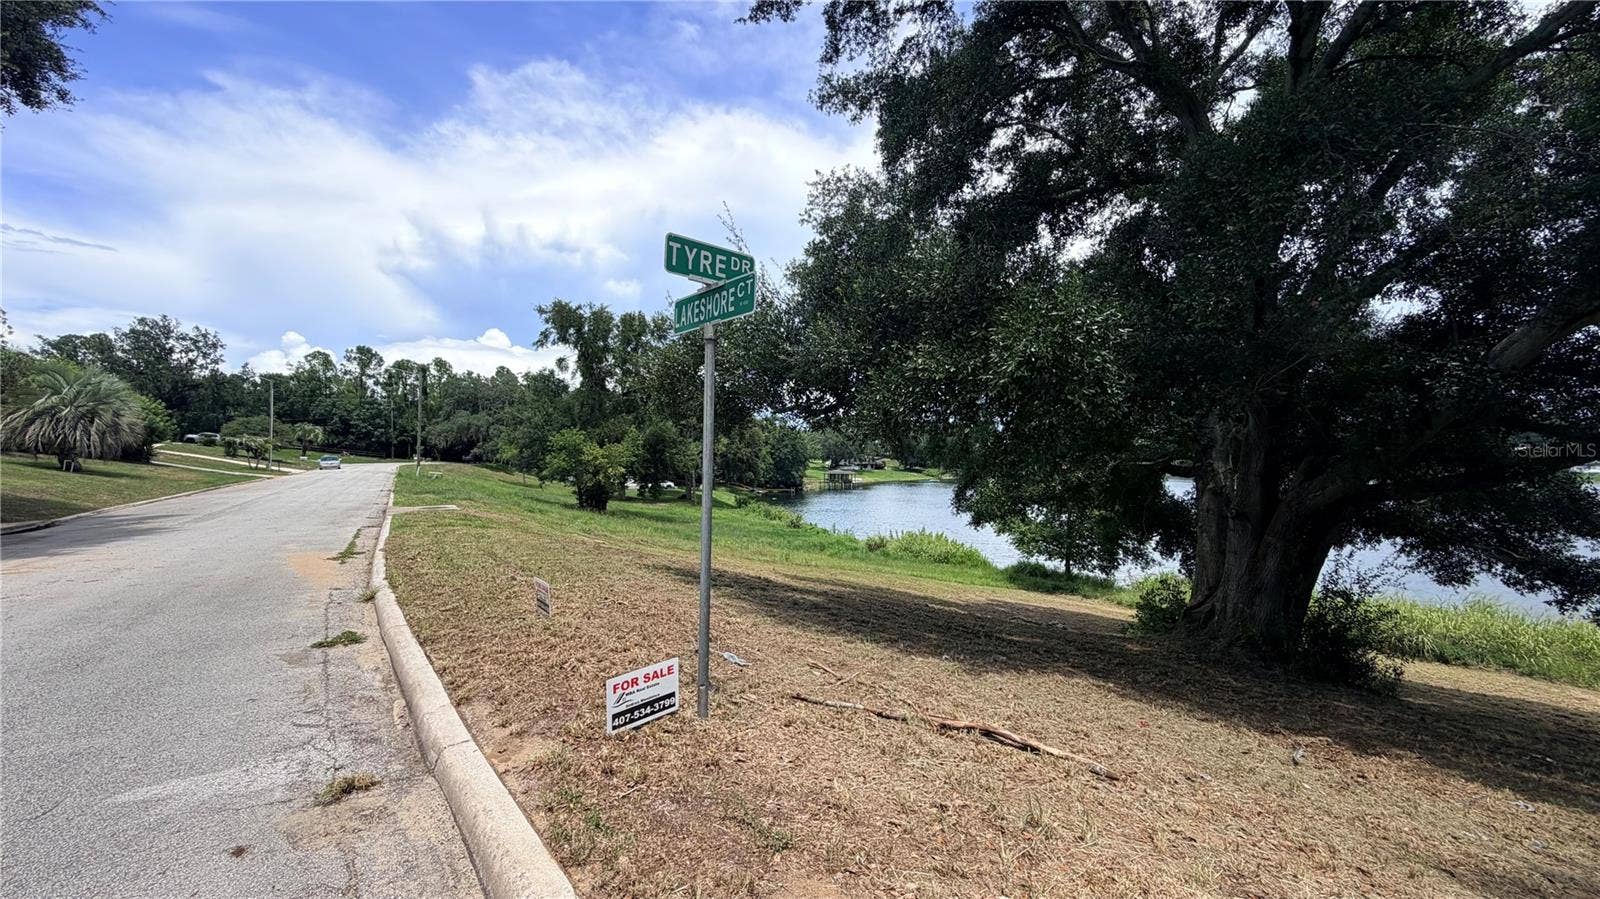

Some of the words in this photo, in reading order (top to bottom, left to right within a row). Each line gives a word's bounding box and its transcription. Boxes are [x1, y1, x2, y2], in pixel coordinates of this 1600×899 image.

[668, 241, 726, 278] TYRE
[731, 257, 751, 273] DR
[675, 288, 735, 328] LAKESHORE
[737, 279, 754, 297] CT
[613, 677, 639, 694] FOR
[643, 664, 675, 683] SALE
[613, 697, 676, 726] 407-534-3799
